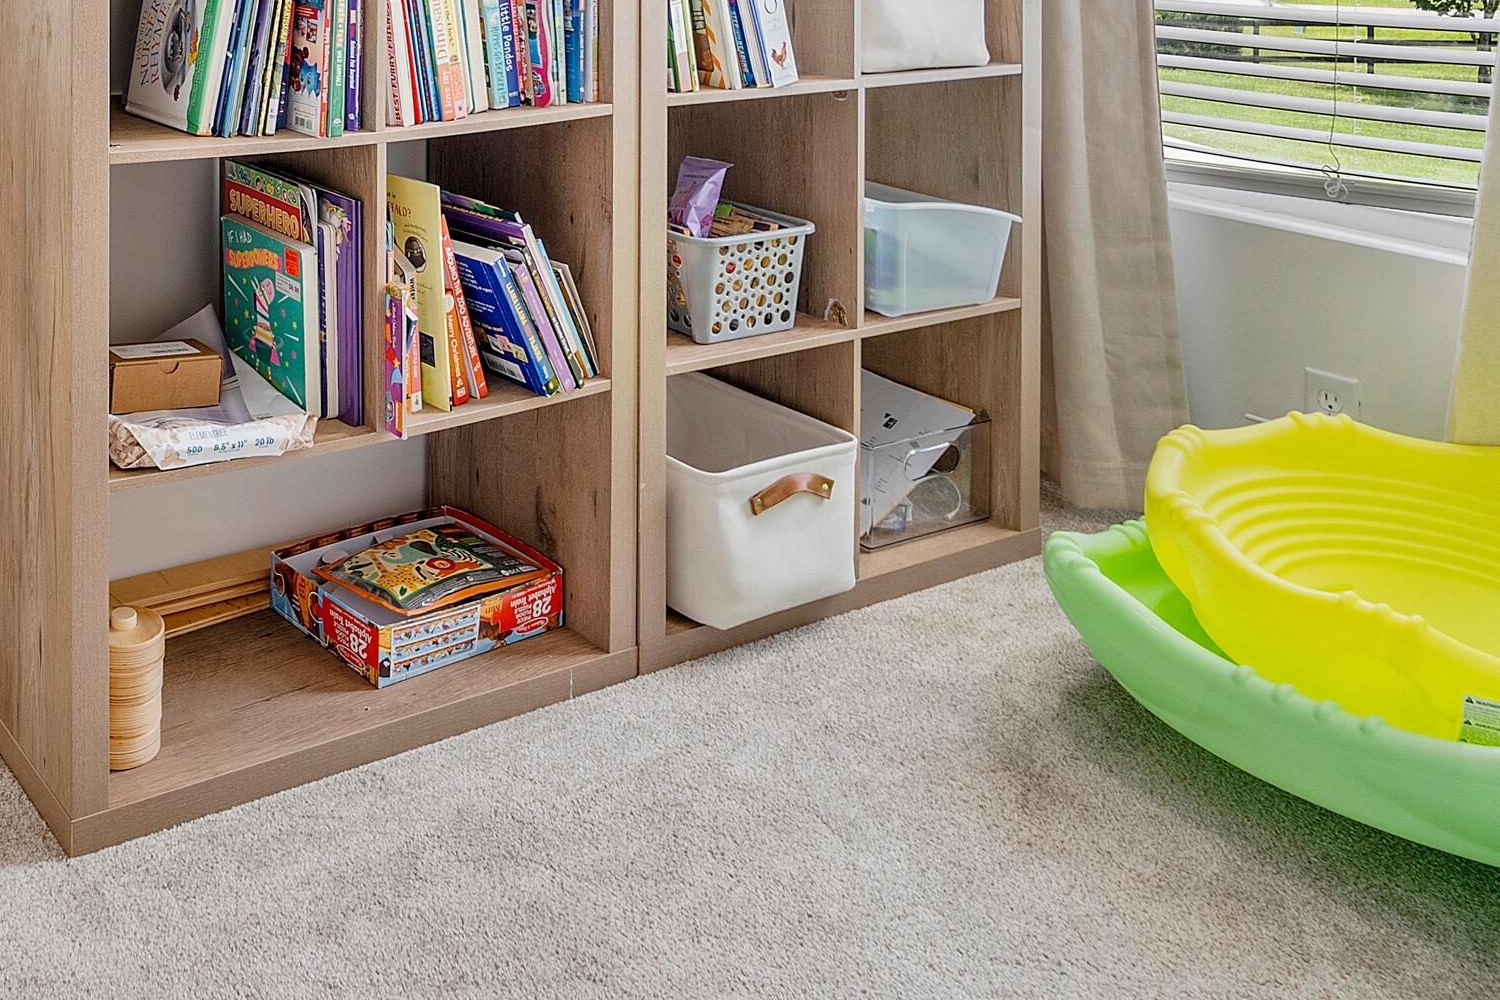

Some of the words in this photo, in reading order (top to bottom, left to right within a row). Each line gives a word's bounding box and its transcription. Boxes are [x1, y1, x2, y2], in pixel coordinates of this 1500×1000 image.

[500, 2, 512, 32] little
[503, 35, 514, 72] Pandas
[737, 39, 750, 74] READING
[388, 55, 398, 89] FURRY
[392, 95, 401, 121] BEST
[229, 189, 300, 240] SUPERHERO
[227, 230, 235, 243] IF
[239, 231, 253, 244] HAD
[446, 247, 458, 281] AROUND
[454, 280, 462, 297] THE
[457, 296, 466, 315] ZOO
[505, 282, 518, 304] LLAMA
[515, 303, 528, 325] LLAMA
[447, 315, 455, 338] Merry
[451, 339, 462, 378] Christmas
[461, 315, 477, 359] ADVENTURE
[186, 445, 203, 454] 500
[254, 438, 266, 447] 20
[266, 436, 275, 446] lb
[510, 596, 528, 609] Train
[528, 584, 558, 602] Alphabet
[532, 595, 552, 617] 28
[349, 633, 368, 659] 28
